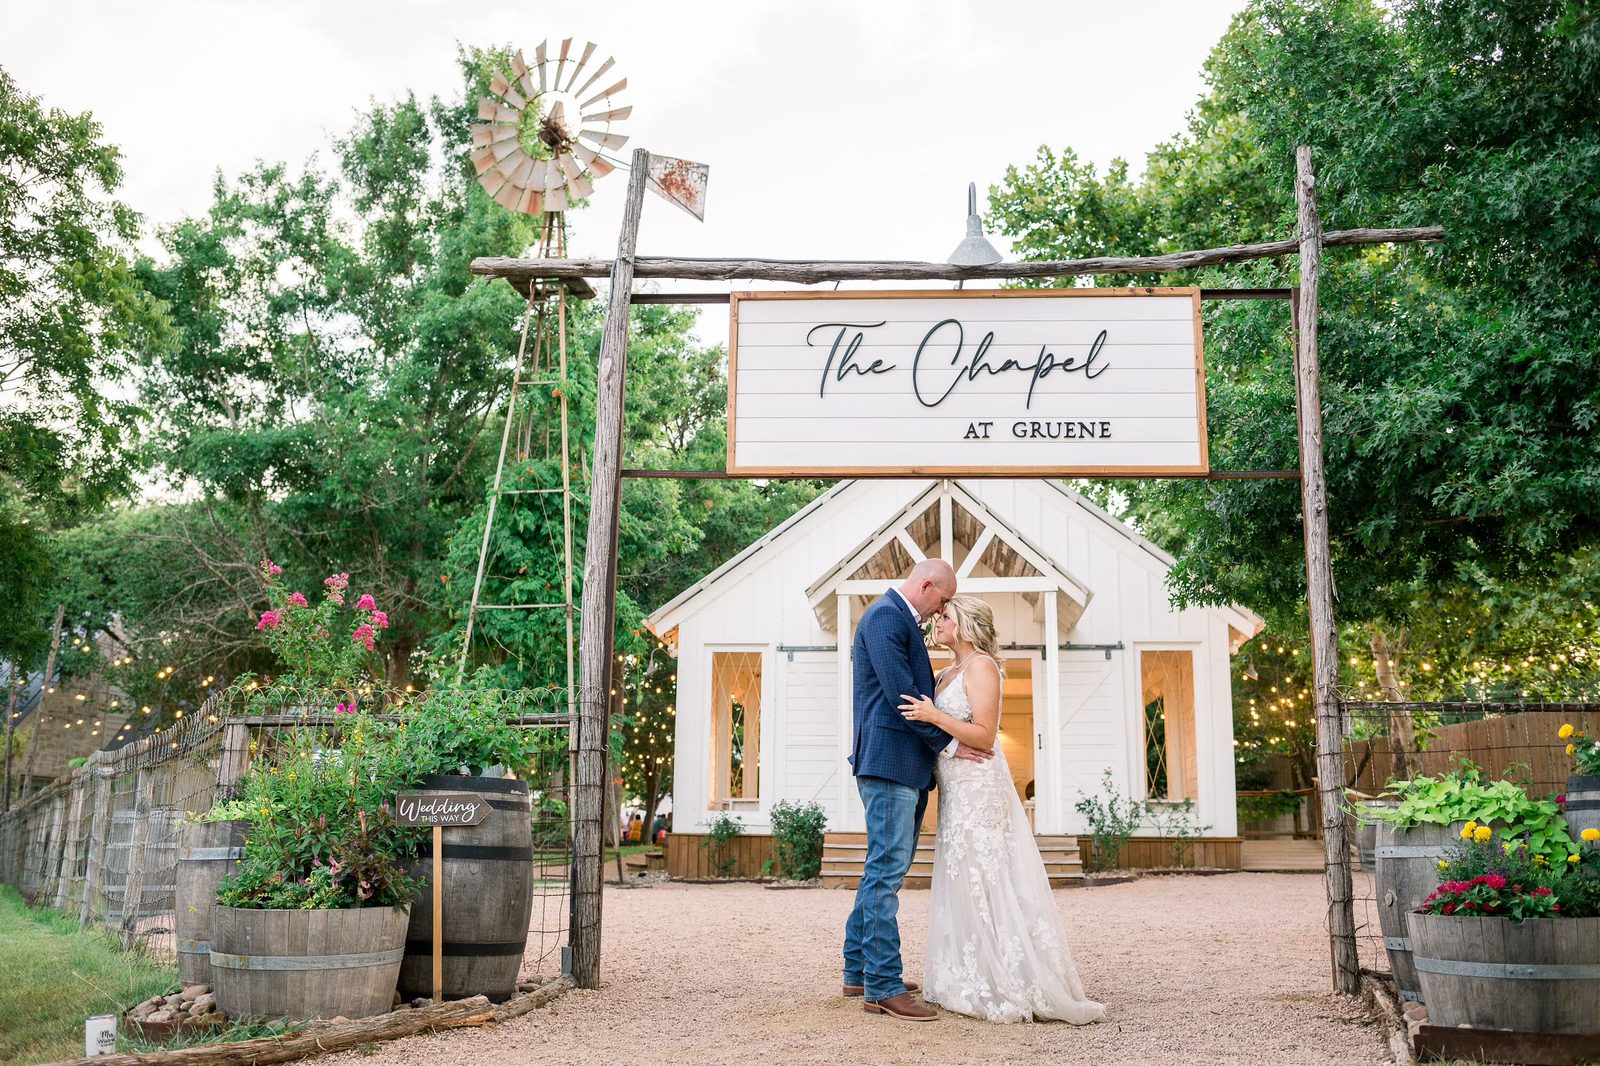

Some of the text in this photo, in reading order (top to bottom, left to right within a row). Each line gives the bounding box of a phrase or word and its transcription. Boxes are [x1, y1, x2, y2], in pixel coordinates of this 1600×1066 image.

[807, 318, 1110, 409] The Chapel
[963, 422, 1111, 439] AT GRUENE
[400, 798, 481, 823] Wedding
[440, 814, 460, 822] WAY
